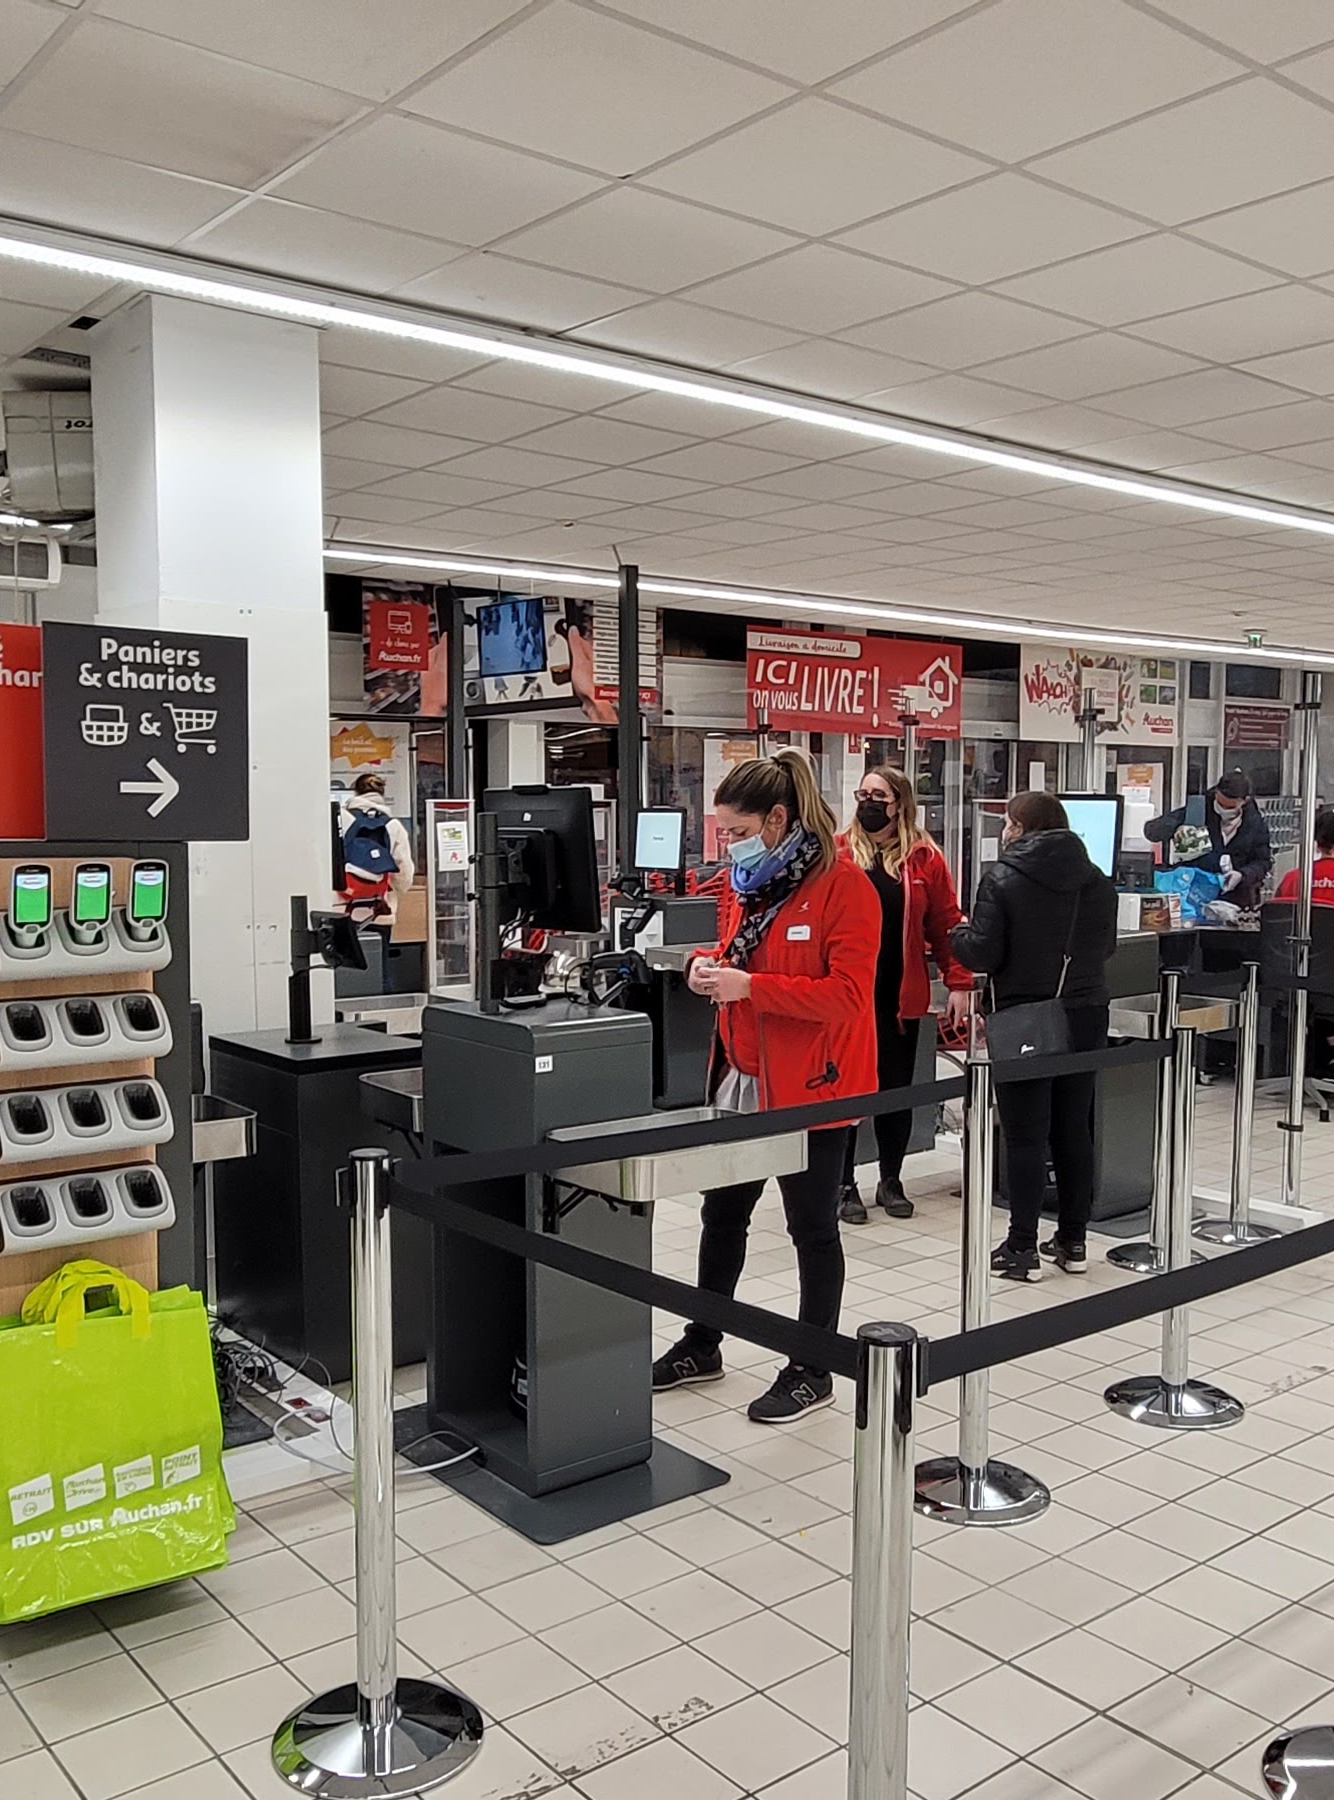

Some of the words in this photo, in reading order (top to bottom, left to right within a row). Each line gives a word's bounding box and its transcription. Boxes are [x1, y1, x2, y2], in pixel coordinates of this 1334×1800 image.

[100, 637, 201, 668] Paniers
[78, 663, 102, 689] &
[106, 664, 217, 694] chariots
[755, 659, 798, 685] ICI
[752, 689, 769, 709] on
[771, 690, 799, 711] vous
[1142, 712, 1173, 727] Auchan
[10, 1486, 52, 1502] RETRAIT
[59, 1517, 104, 1539] SUR
[110, 1493, 204, 1528] Auchan.fr
